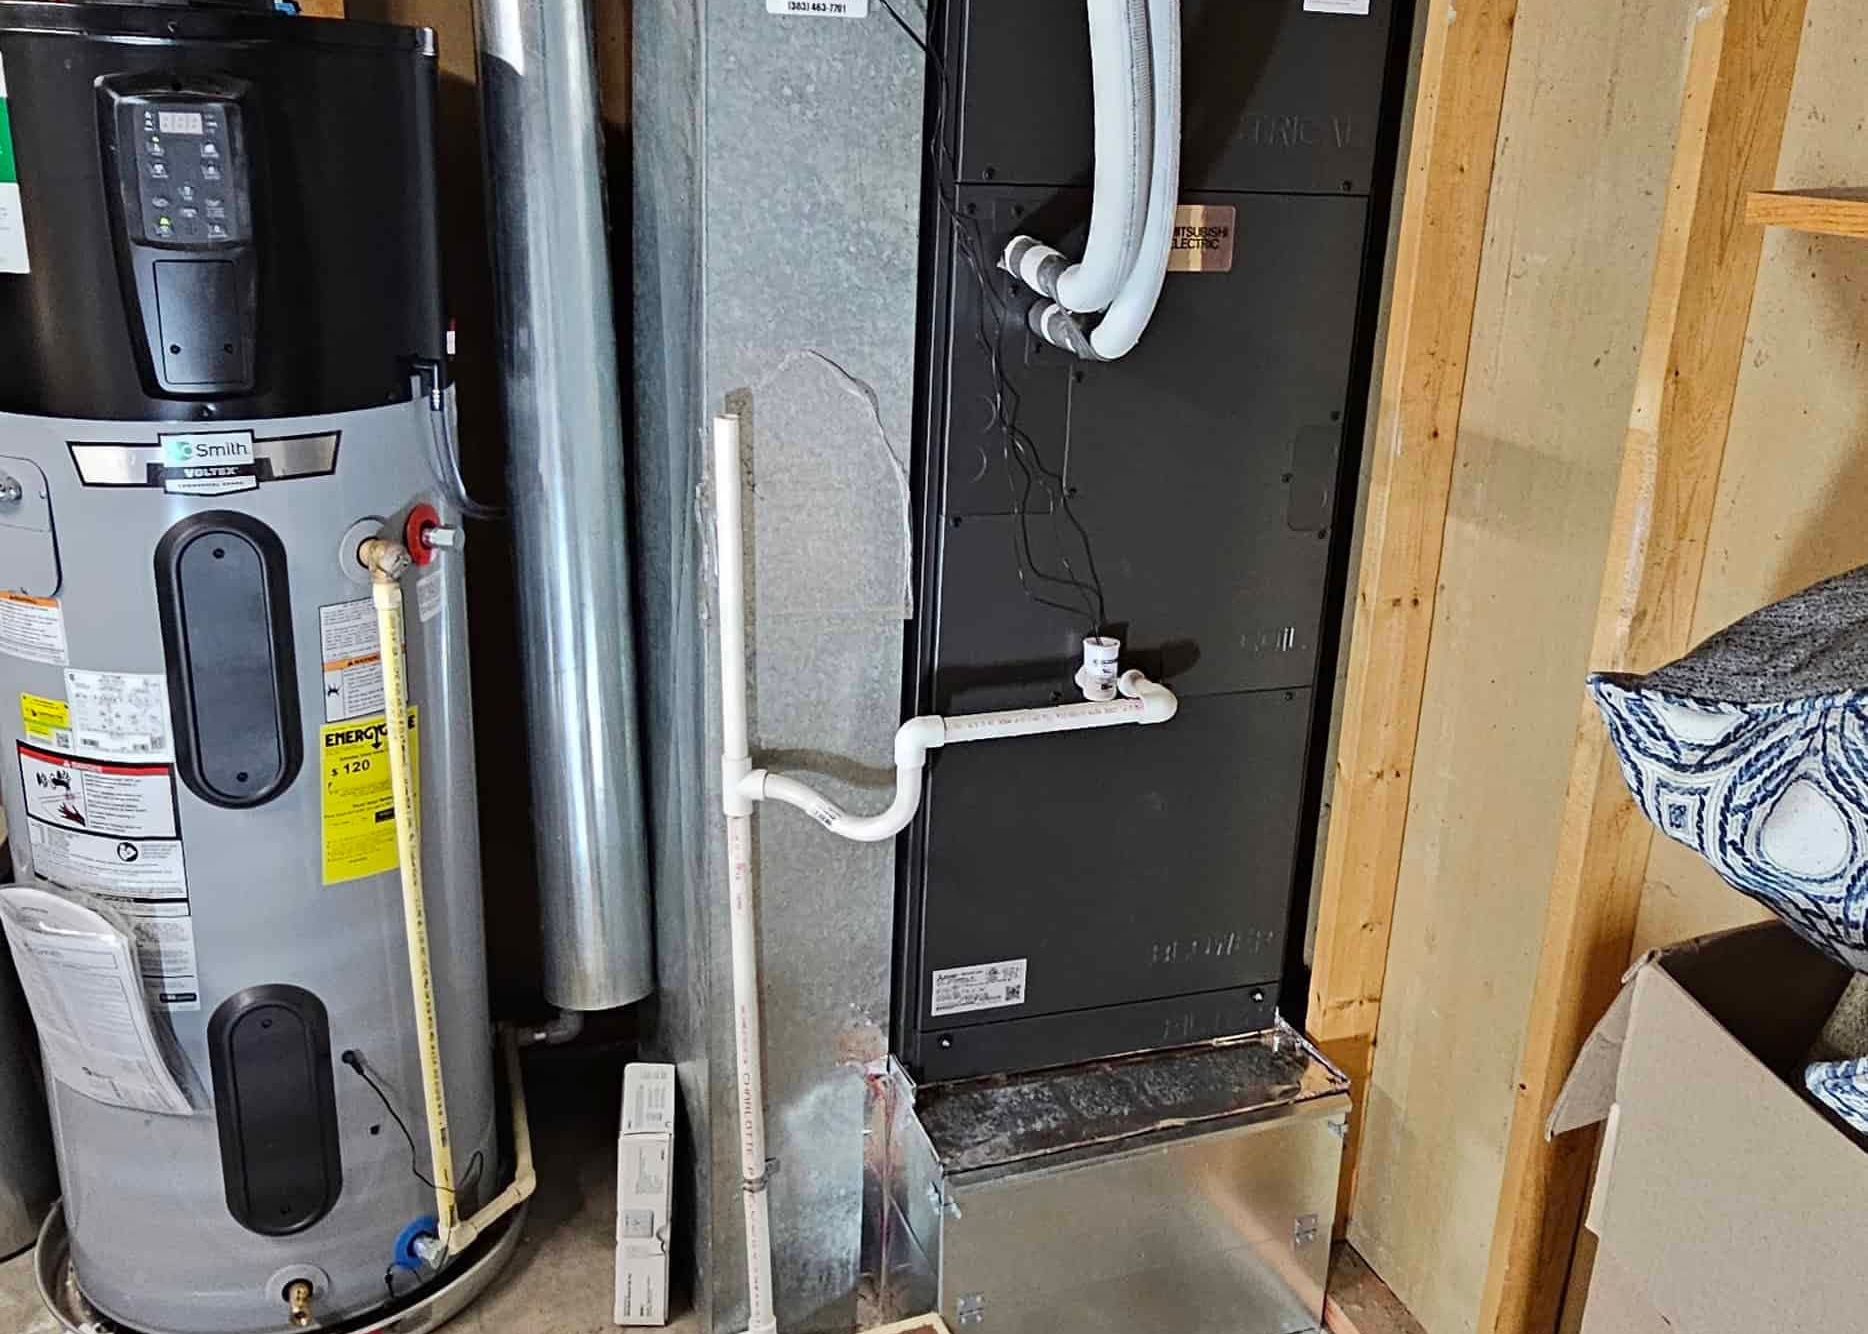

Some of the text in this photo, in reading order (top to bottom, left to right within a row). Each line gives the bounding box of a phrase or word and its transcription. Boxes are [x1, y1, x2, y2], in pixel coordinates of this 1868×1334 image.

[1174, 226, 1228, 237] ITSUBISHI
[195, 442, 248, 458] Smith
[344, 759, 370, 775] 120
